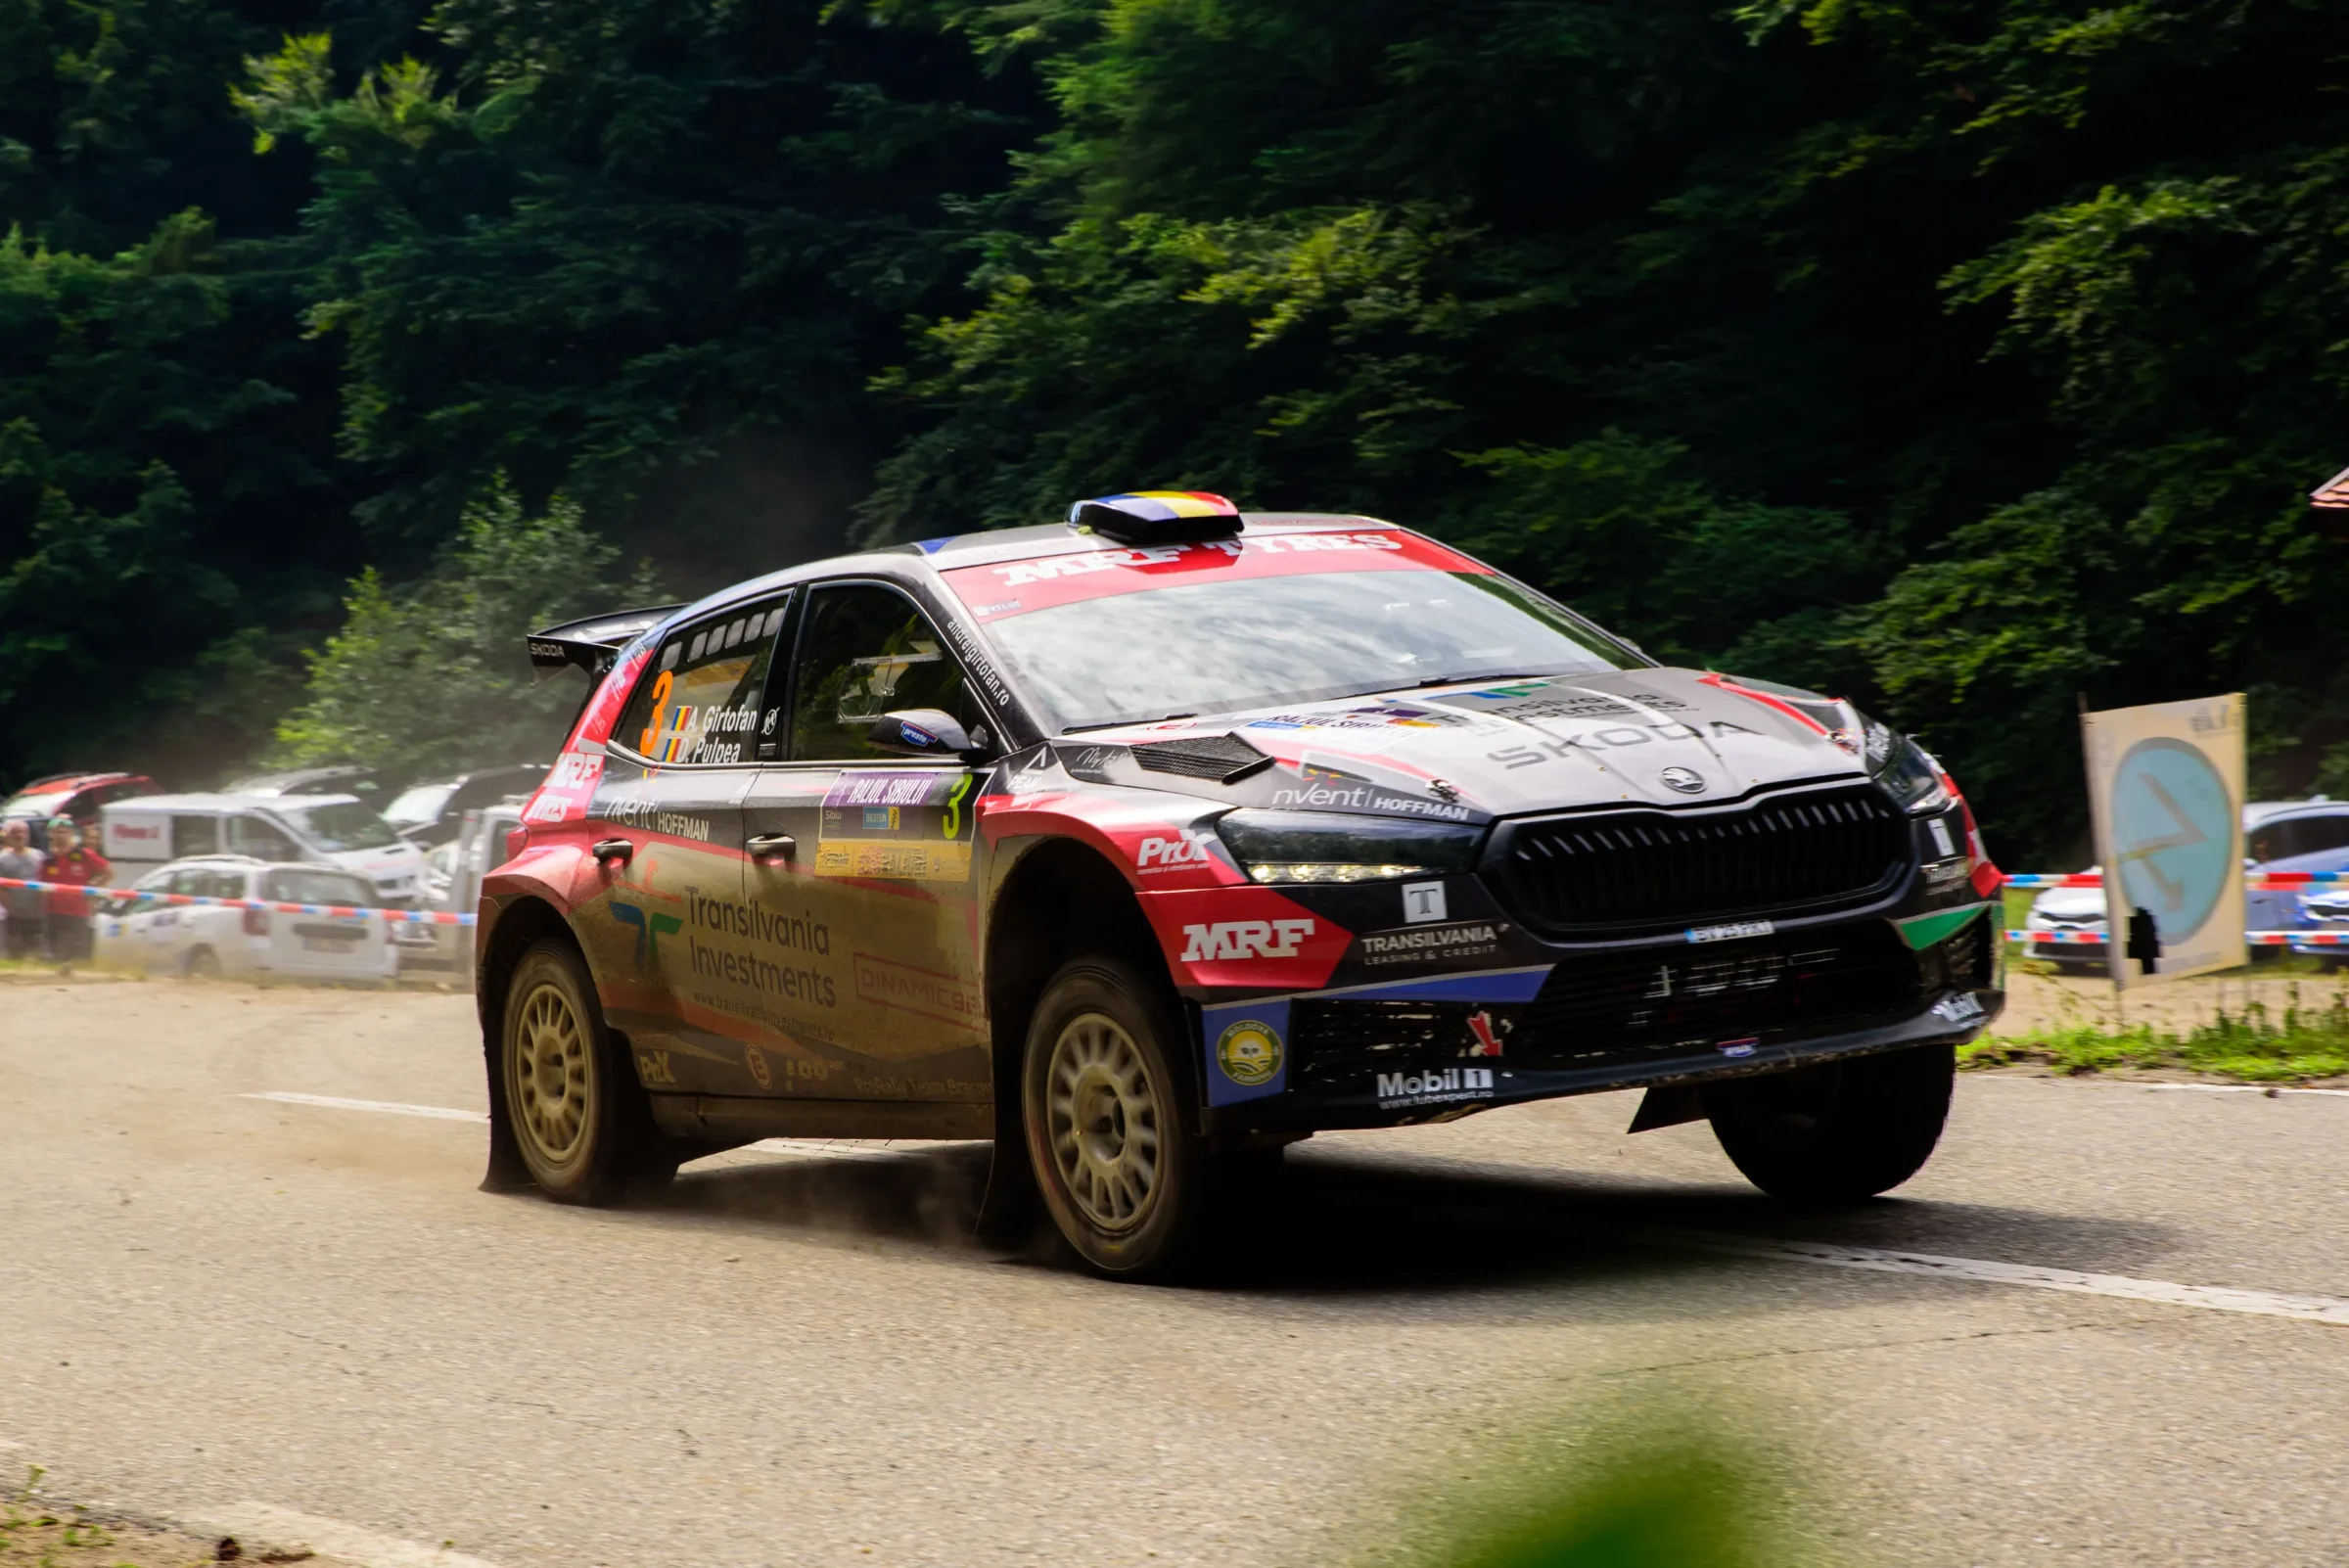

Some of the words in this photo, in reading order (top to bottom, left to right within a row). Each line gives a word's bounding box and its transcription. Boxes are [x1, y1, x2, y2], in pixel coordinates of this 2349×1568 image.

[991, 541, 1183, 587] MRF
[1207, 531, 1404, 557] TYRES
[947, 619, 1009, 706] andreigirtofan.ro
[639, 669, 674, 757] 3
[685, 706, 699, 732] A.
[703, 704, 758, 732] Gîrtofan
[675, 737, 689, 763] D.
[691, 736, 741, 763] Pulpea
[903, 727, 928, 744] presto
[847, 778, 889, 804] RALIUL
[881, 778, 933, 805] SIBIULUI
[943, 772, 974, 840] 3
[1271, 782, 1365, 807] nvent
[1373, 797, 1470, 821] HOFFMAN
[657, 811, 710, 842] HOFFMAN
[824, 809, 842, 821] Sibiu
[686, 886, 830, 955] Transilvania
[1180, 918, 1314, 962] MRF
[1360, 925, 1497, 953] TRANSILVANIA
[1364, 952, 1420, 966] LEASING
[1424, 949, 1437, 960] &
[1442, 944, 1497, 957] CREDIT
[689, 935, 836, 1008] Investments
[1377, 1068, 1460, 1097] Mobil
